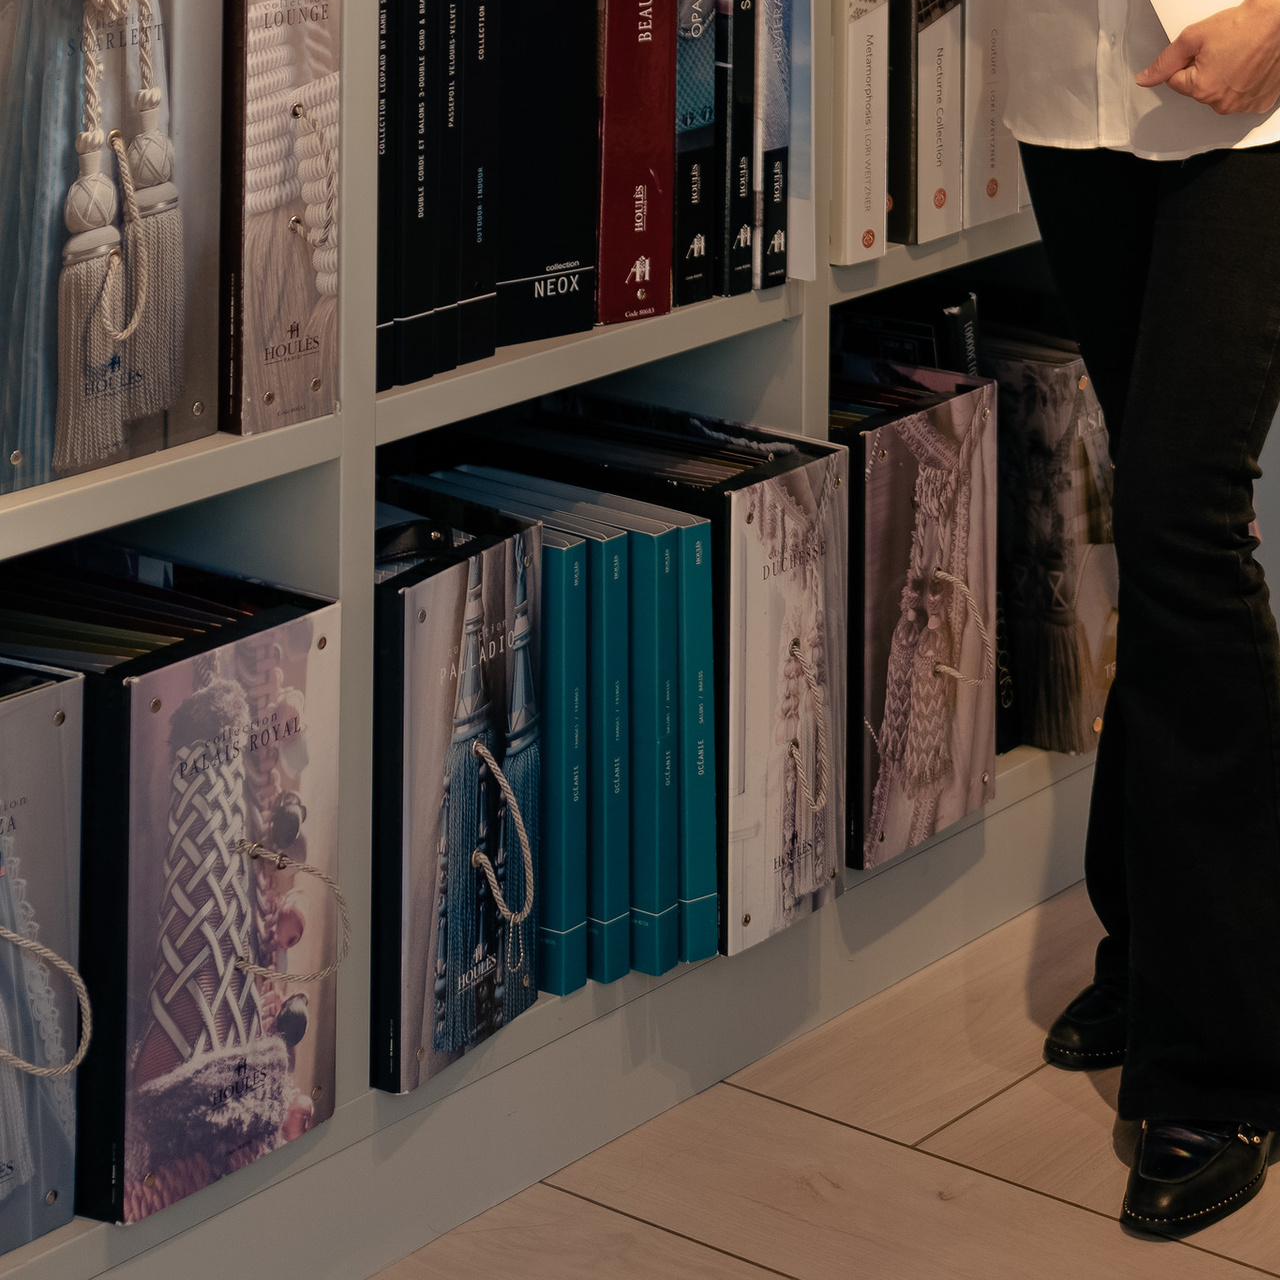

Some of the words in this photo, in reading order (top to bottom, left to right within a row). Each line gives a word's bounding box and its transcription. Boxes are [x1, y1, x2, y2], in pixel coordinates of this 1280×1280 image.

[264, 3, 329, 29] LOUNGE
[478, 6, 486, 60] COLLECTION
[67, 24, 165, 57] SCARLETT
[380, 39, 387, 50] BY
[989, 28, 998, 75] Couture
[379, 54, 387, 93] LEOPARD
[864, 34, 874, 126] Metamorphosis
[936, 47, 944, 104] Nocturne
[379, 98, 387, 155] COLLECTION
[418, 140, 425, 150] ET
[864, 132, 873, 155] LORI
[935, 107, 944, 168] Collection
[864, 158, 873, 213] WEITZNER
[632, 184, 644, 232] HOULÈS
[545, 260, 580, 272] collection
[534, 274, 580, 299] NEOX
[625, 310, 639, 318] Code
[264, 334, 320, 361] HOULÈS
[440, 630, 515, 686] PALLADIO
[178, 740, 241, 780] PALAIS
[249, 716, 302, 753] ROYAL
[204, 712, 279, 748] collection
